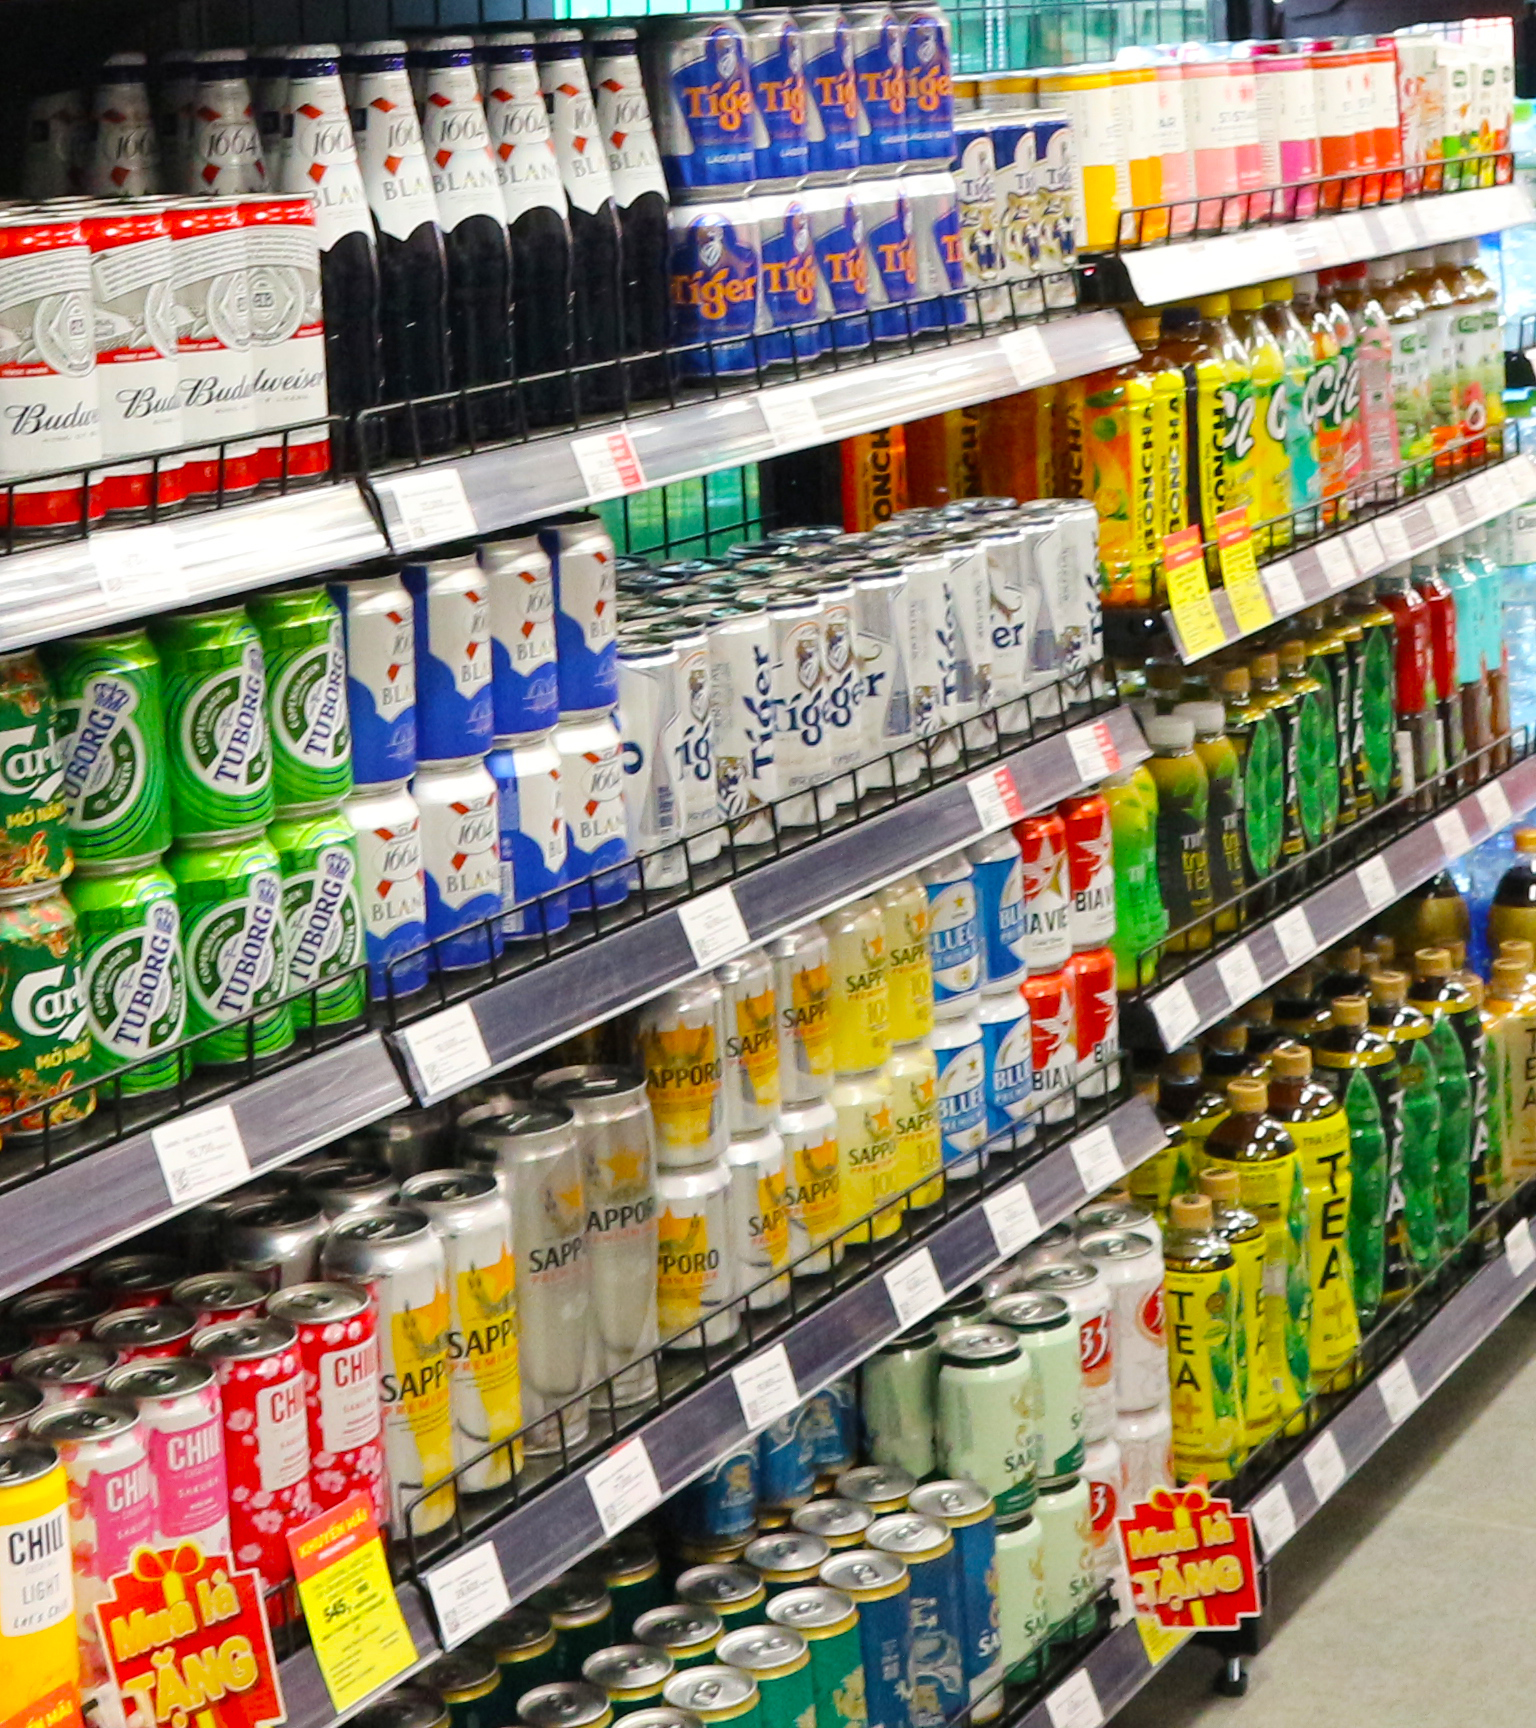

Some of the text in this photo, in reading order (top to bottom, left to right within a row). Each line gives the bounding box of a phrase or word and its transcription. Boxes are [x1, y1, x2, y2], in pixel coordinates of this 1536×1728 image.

[213, 672, 265, 787] TUBORG
[303, 652, 346, 760] TUBORG
[113, 922, 173, 1050] TUBORG
[216, 898, 274, 1018] TUBORG
[647, 1063, 724, 1090] APPORO
